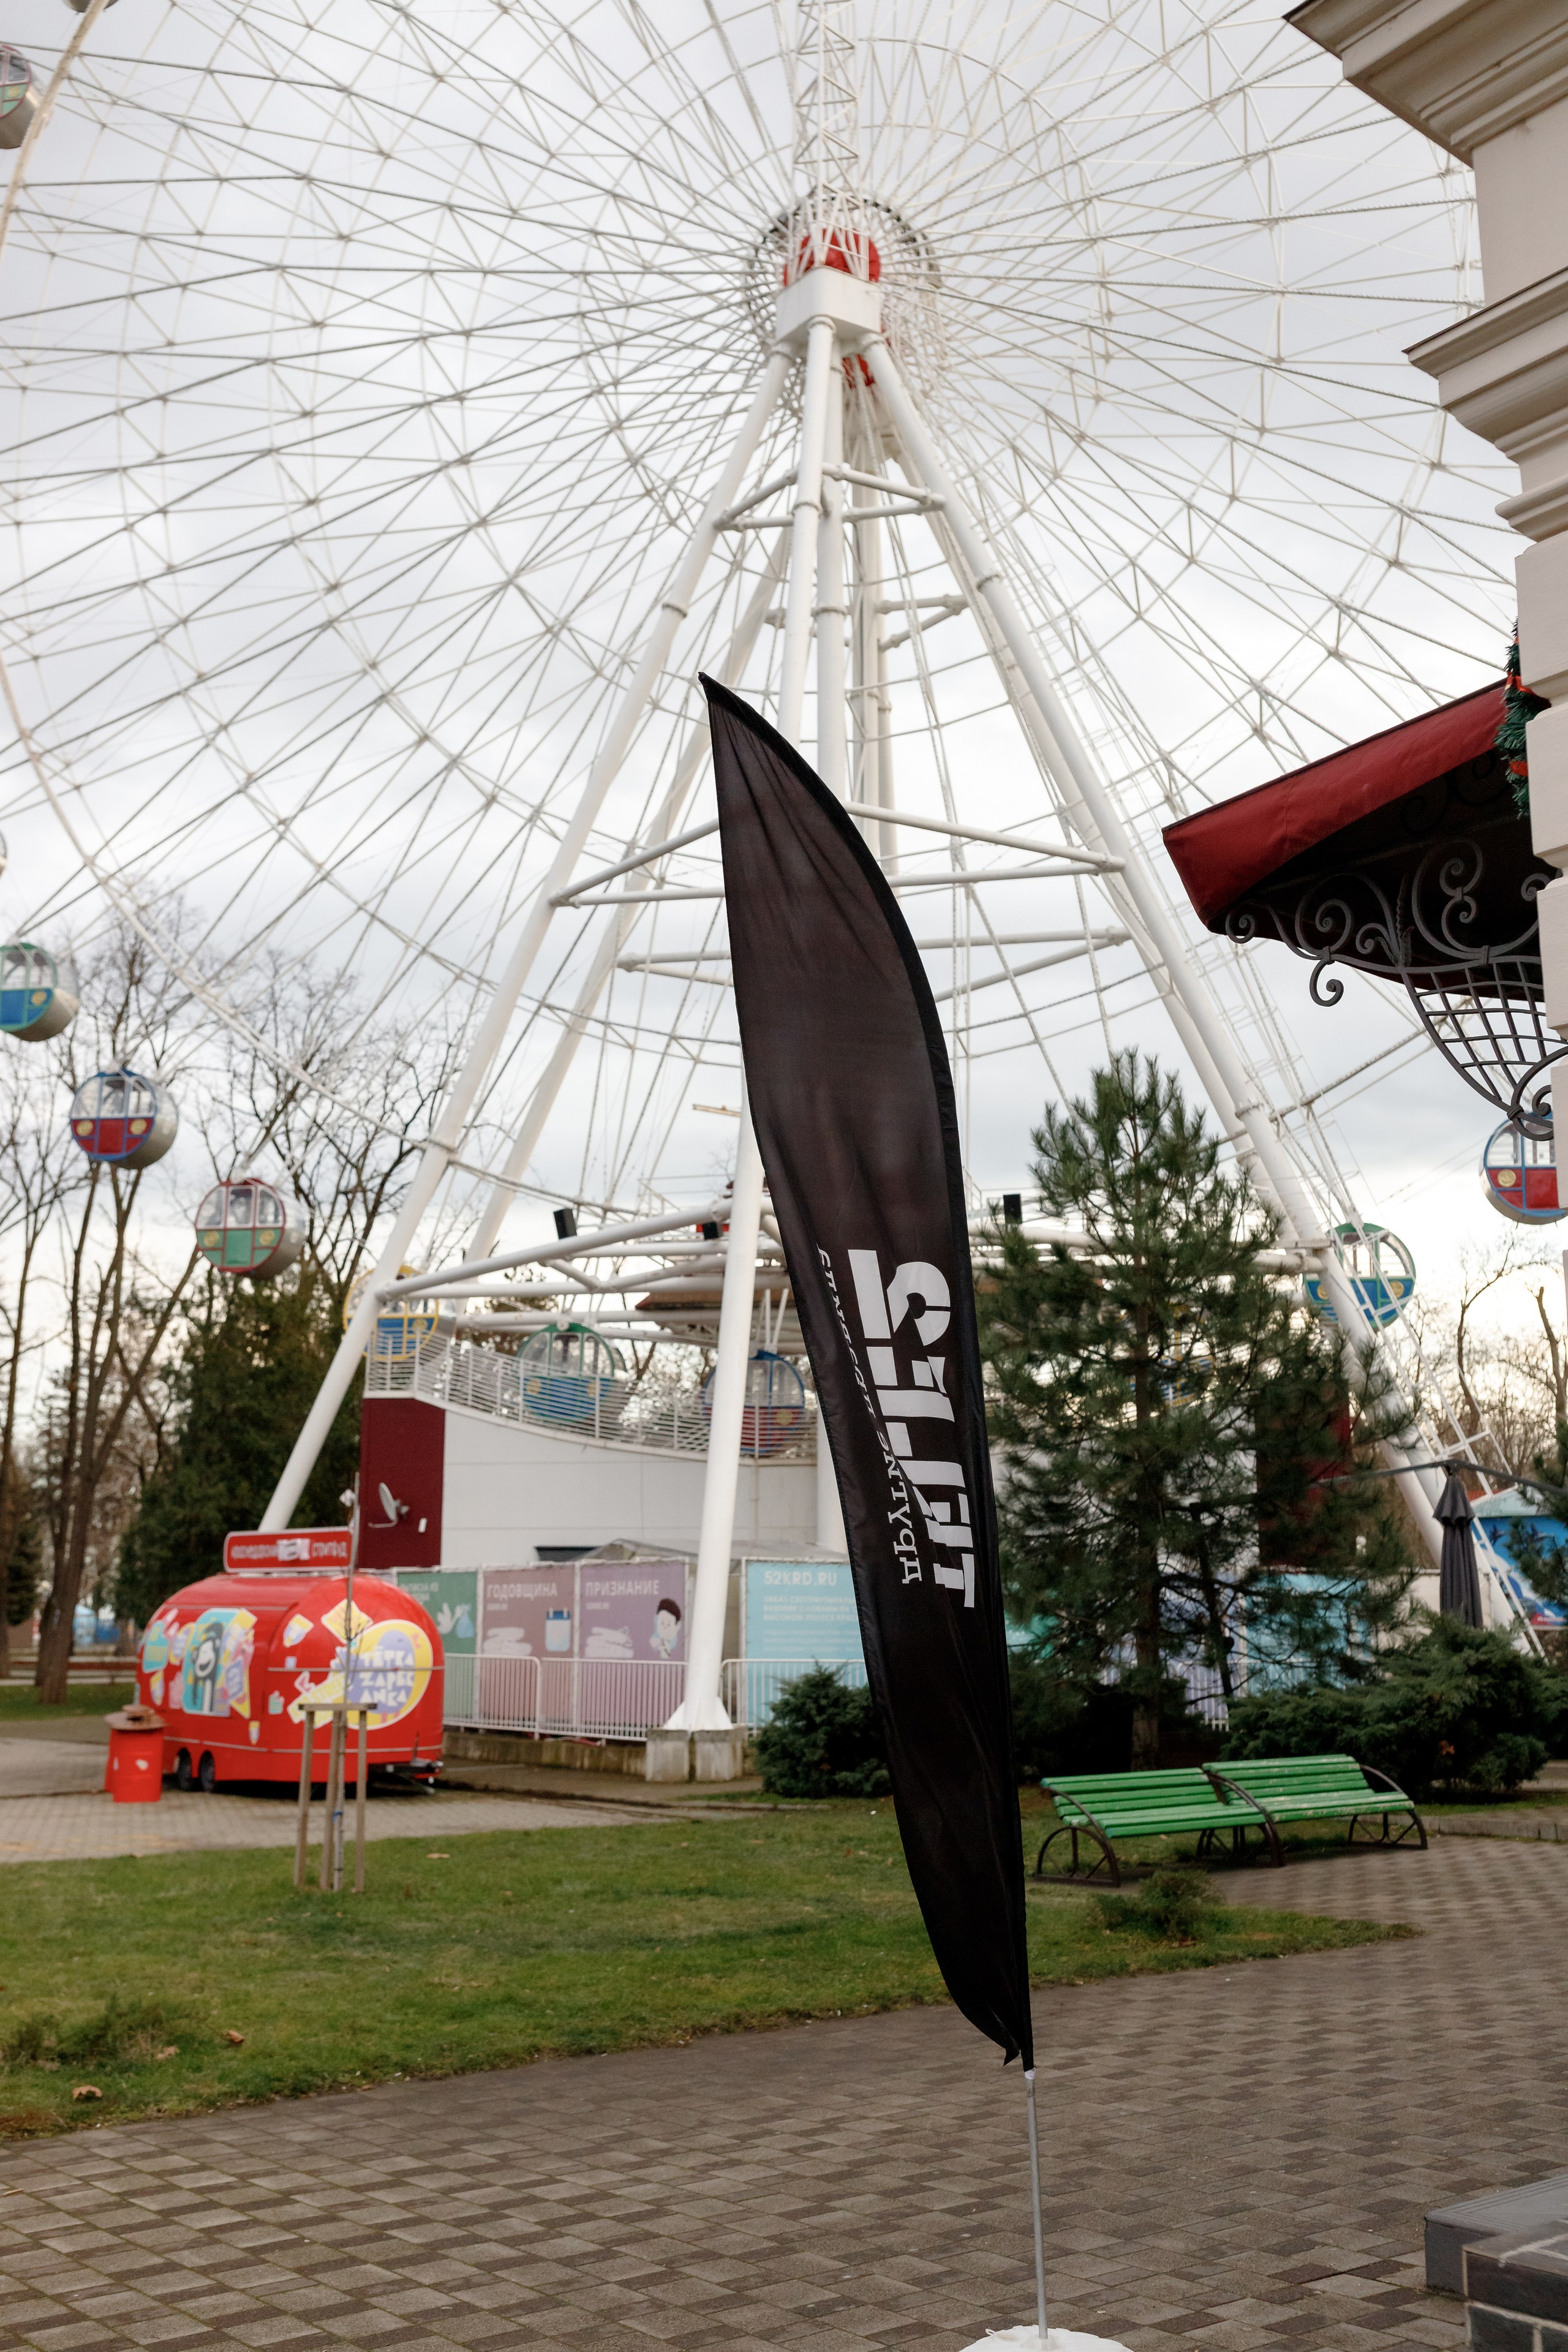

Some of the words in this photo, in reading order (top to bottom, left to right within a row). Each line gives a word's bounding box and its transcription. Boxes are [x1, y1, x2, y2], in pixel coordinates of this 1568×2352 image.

[764, 1571, 837, 1586] 52KRD.RU
[487, 1583, 557, 1600] ГОДОВЩИНА
[586, 1580, 660, 1596] ПРИЗНАНИЕ
